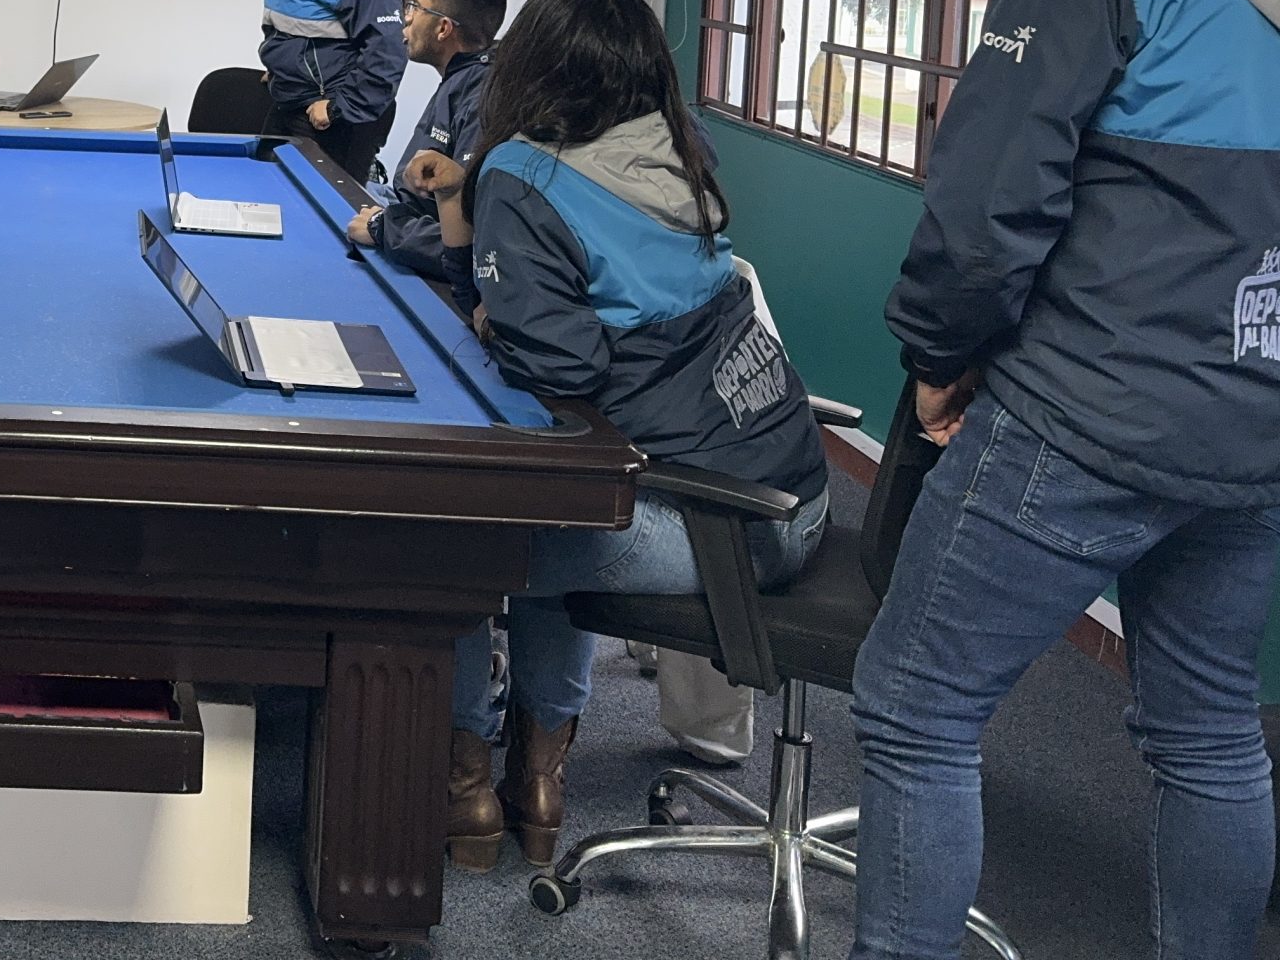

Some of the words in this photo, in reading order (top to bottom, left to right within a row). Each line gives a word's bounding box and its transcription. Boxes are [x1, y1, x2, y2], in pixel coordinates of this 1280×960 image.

[1240, 326, 1260, 357] AL
[716, 322, 775, 399] DEPORTE
[732, 393, 747, 423] AL
